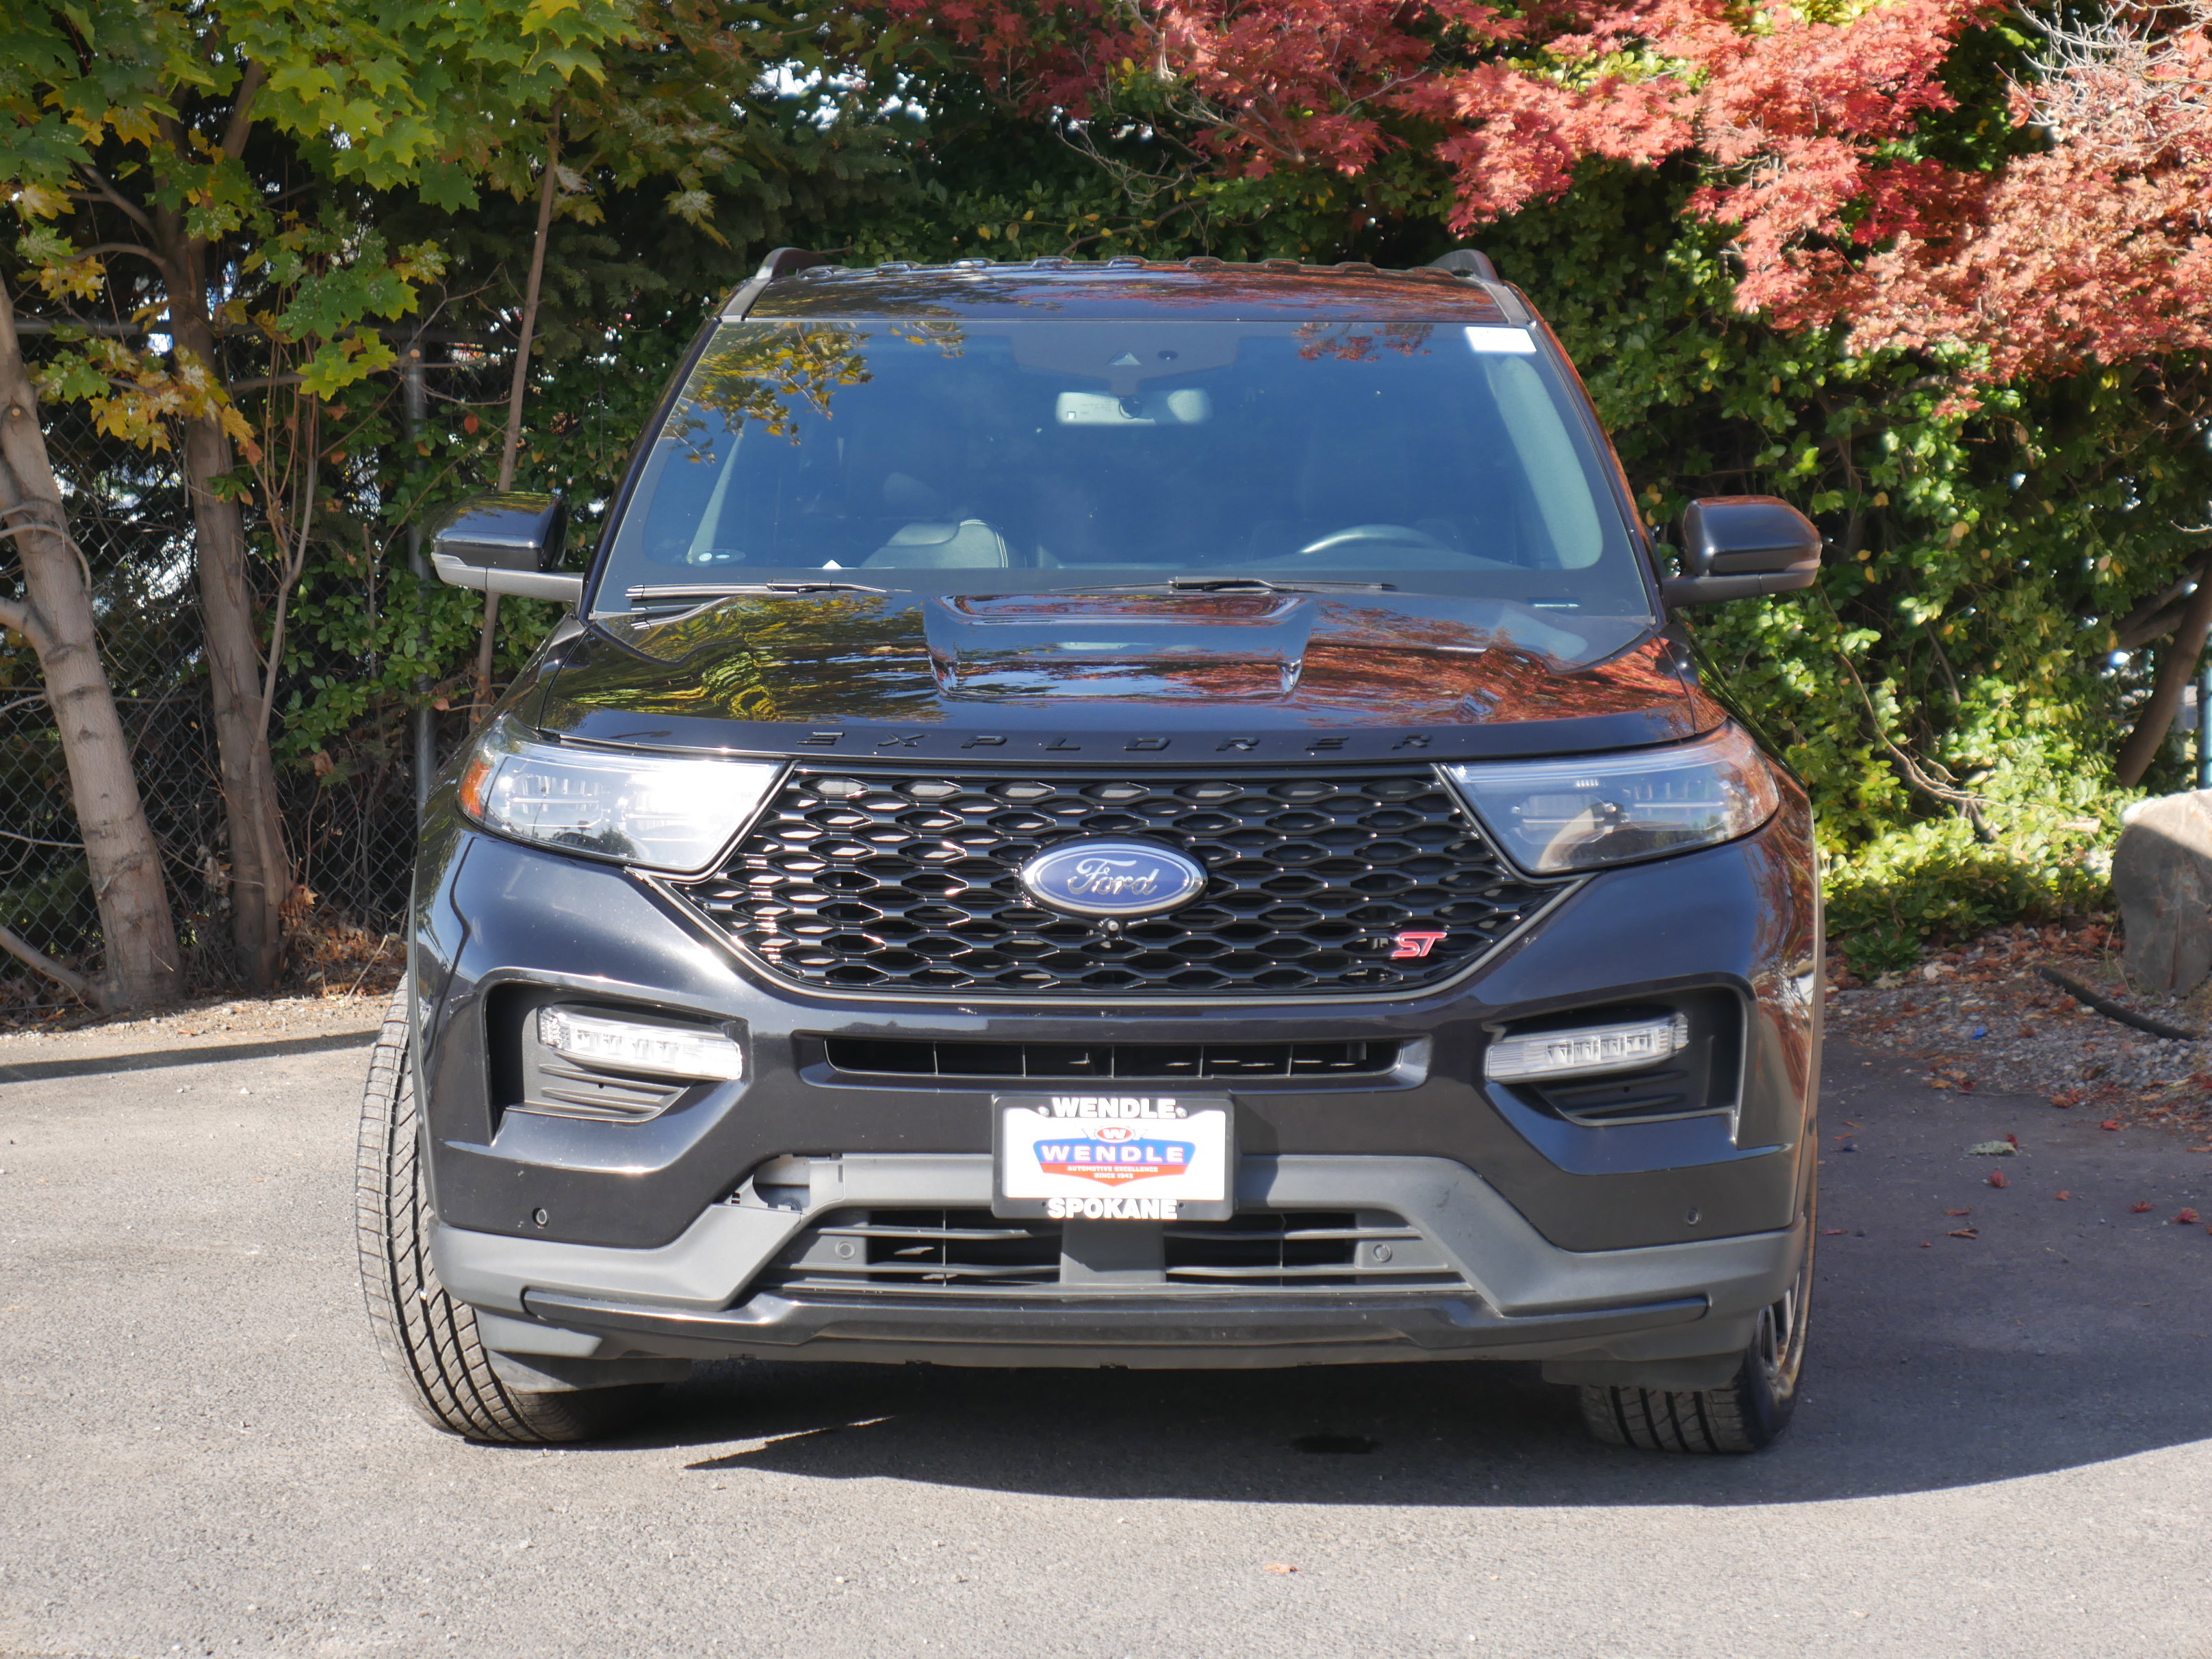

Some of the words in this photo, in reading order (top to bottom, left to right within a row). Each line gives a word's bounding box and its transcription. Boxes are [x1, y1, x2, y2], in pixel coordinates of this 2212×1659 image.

[797, 731, 1432, 751] EXPLORER
[1068, 858, 1161, 895] Ford
[1392, 931, 1447, 957] ST
[1052, 1097, 1176, 1118] WENDLE
[1042, 1146, 1184, 1162] WENDLE
[1047, 1198, 1178, 1220] SPOKANE
